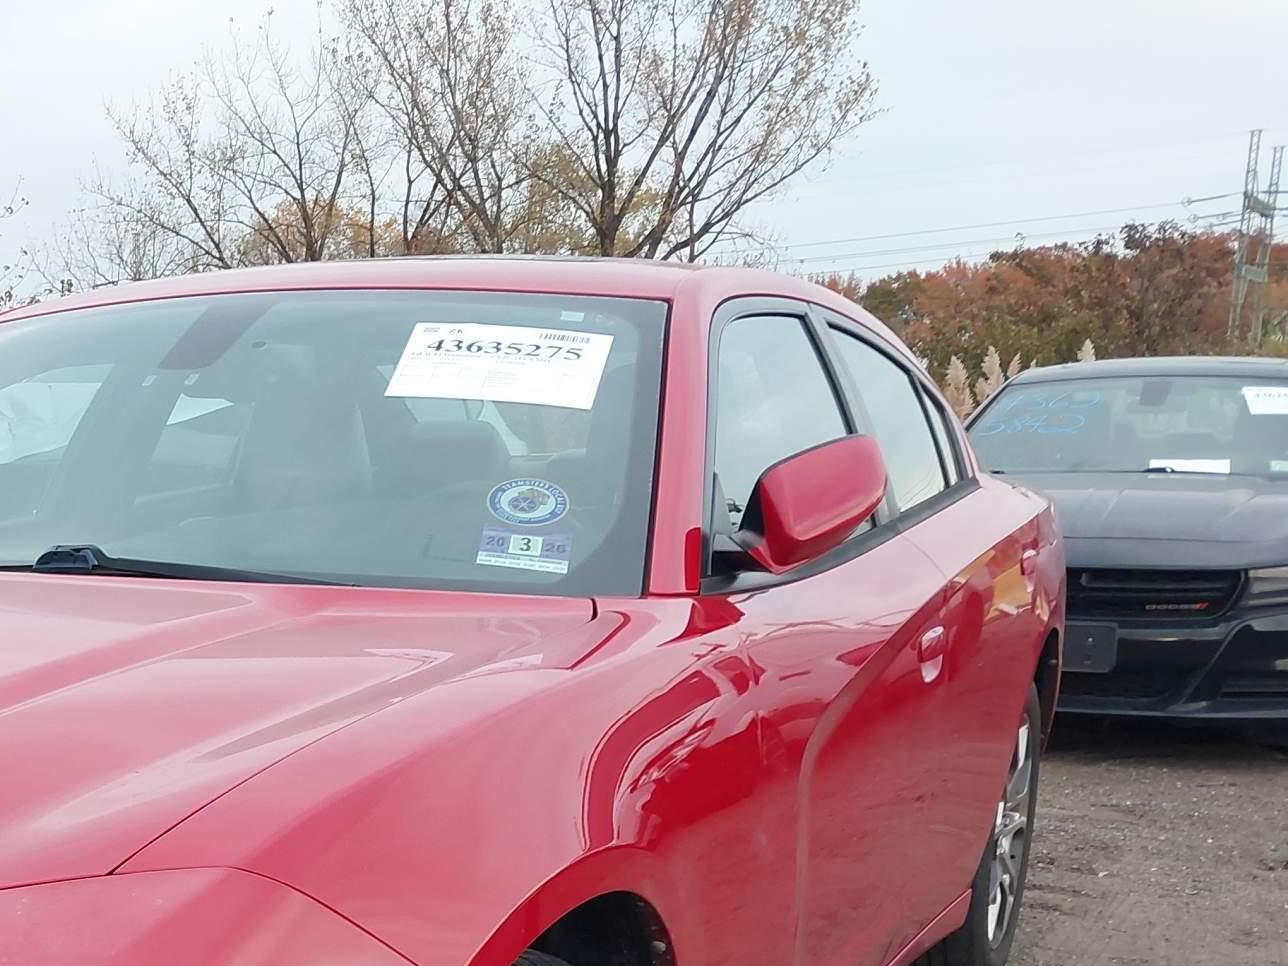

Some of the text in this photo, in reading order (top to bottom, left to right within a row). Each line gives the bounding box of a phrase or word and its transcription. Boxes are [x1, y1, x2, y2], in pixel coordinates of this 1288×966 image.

[426, 338, 584, 361] 43635275
[486, 536, 506, 547] 20
[519, 537, 532, 552] 3
